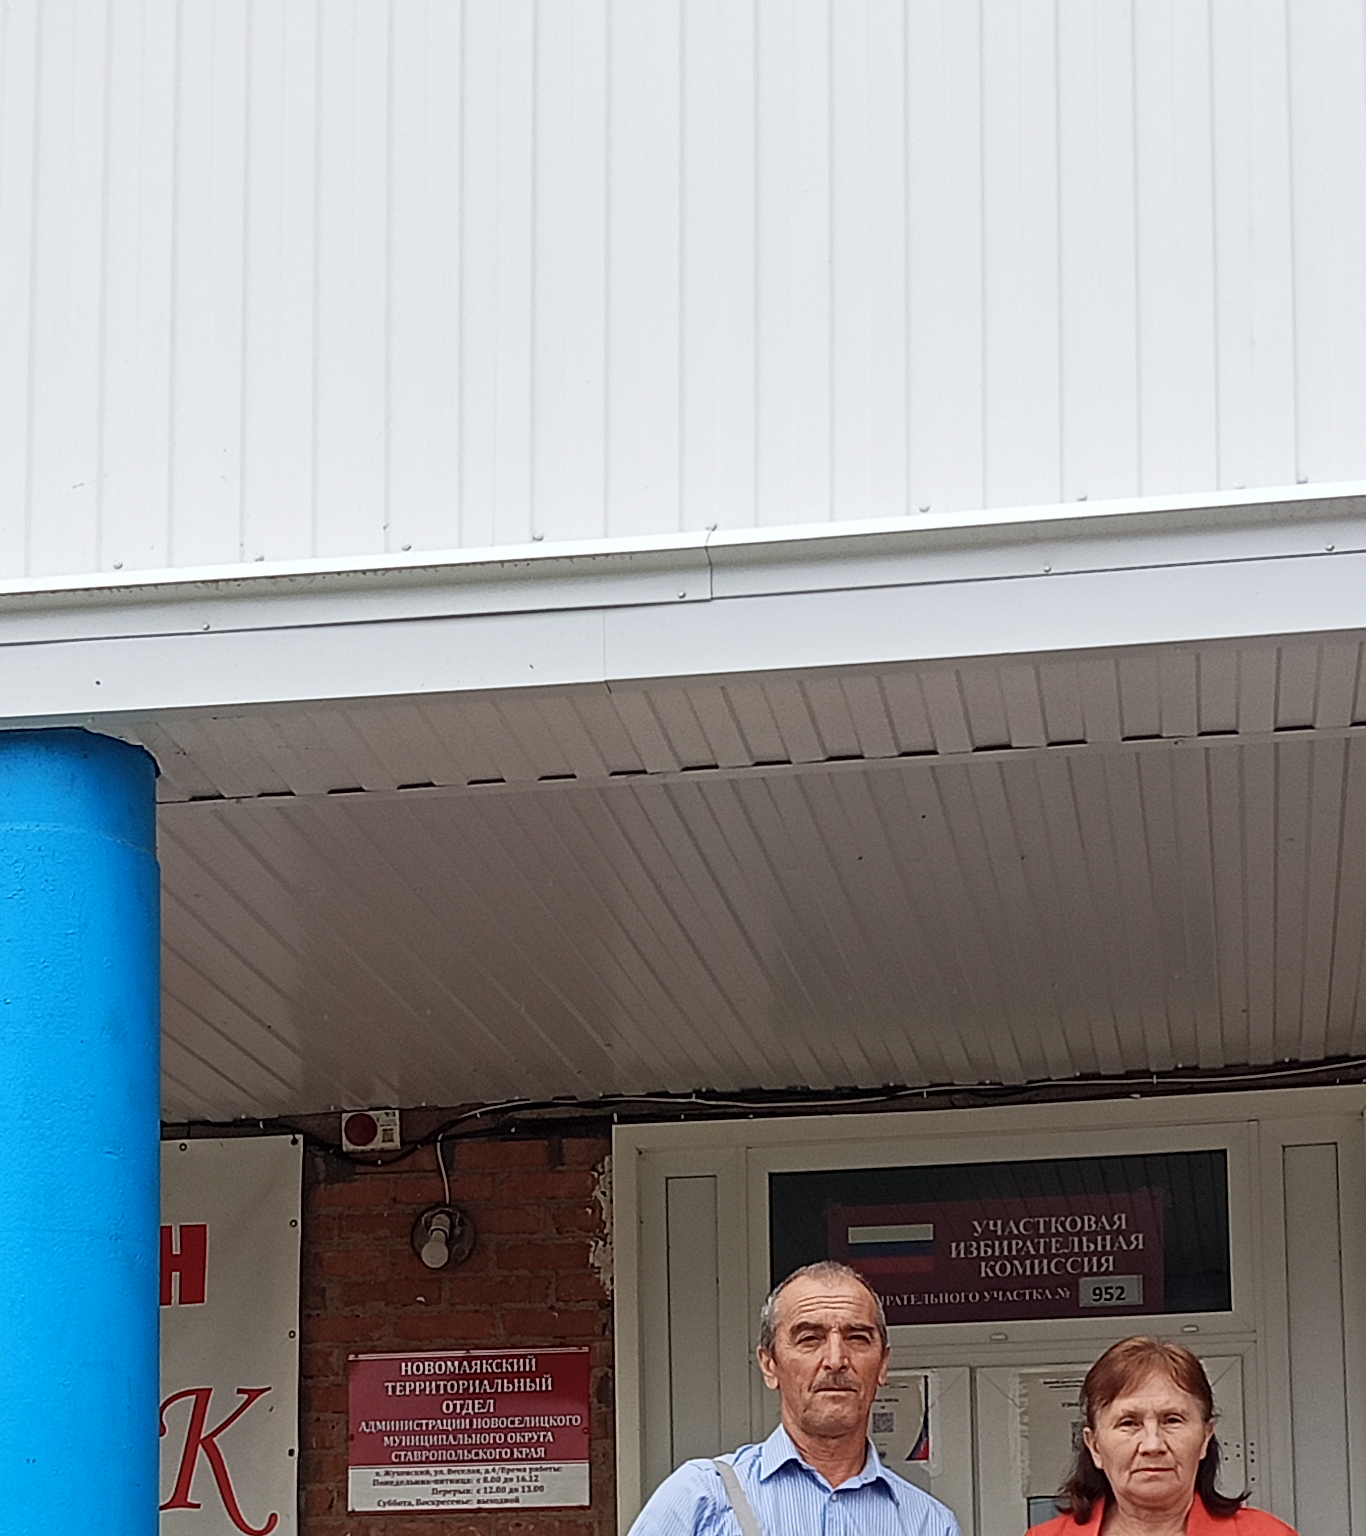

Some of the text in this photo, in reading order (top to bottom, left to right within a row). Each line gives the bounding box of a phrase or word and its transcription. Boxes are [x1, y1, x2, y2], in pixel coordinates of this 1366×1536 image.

[971, 1213, 1128, 1237] УЧАСТКОВАЯ
[950, 1233, 1145, 1259] ИЗБИРАТЕЛЬНАЯ
[980, 1255, 1115, 1278] КОМИССИЯ
[879, 1291, 980, 1306] ИРАТЕЛЬНОГО
[983, 1288, 1053, 1303] УЧАСТКА
[1091, 1286, 1127, 1303] 952
[400, 1354, 537, 1376] НОВОМАЯКСКИЙ
[384, 1373, 553, 1396] ТЕРРИТОРИАЛЬНЫЙ
[441, 1399, 495, 1415] ОТДЕЛ
[358, 1414, 582, 1433] АДМИНИСТРАЦИИ НОВОСЕЛИЦКОГО
[383, 1430, 554, 1448] МУНИЦИПАЛЬНОГО ОКРУГА
[391, 1446, 546, 1462] СТАВРОПОЛЬСКОГО КРАЯ
